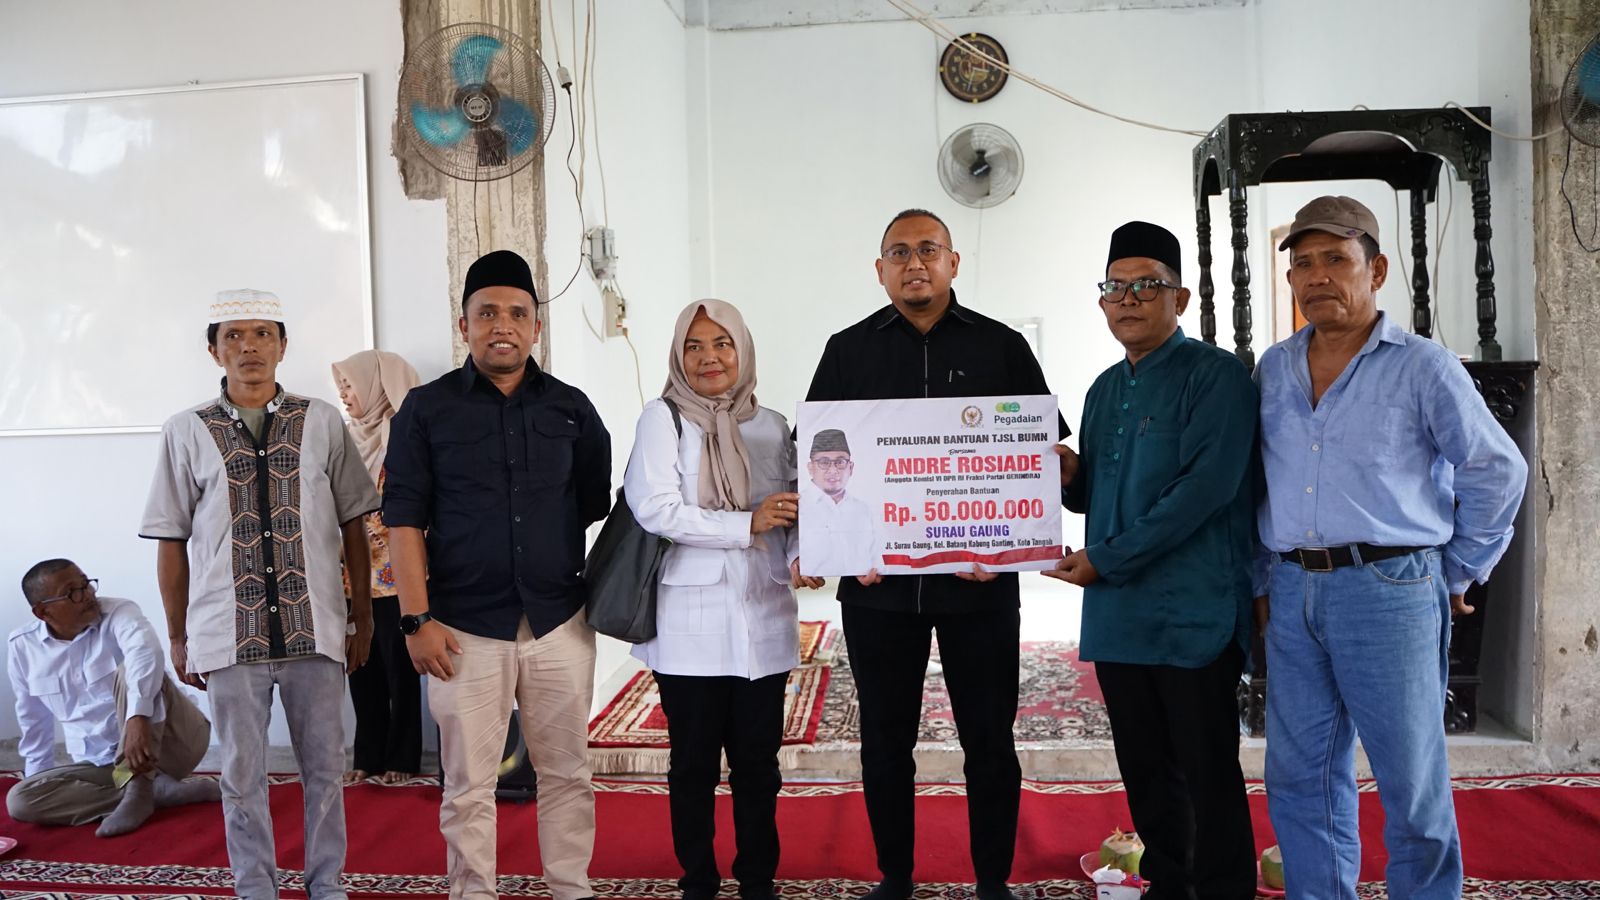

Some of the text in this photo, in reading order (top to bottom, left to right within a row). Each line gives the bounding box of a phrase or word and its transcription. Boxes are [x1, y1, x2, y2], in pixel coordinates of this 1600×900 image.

[994, 414, 1042, 425] Pegadaian
[877, 432, 1048, 446] PENYALURAN BANTUAN TJSL BUMN
[885, 454, 1042, 475] ANDRE ROSIADE
[926, 487, 1000, 497] Penyerahan Bantuan
[884, 498, 1044, 527] Rp. 50.000.000
[926, 525, 1010, 538] SURAU GAUNG
[894, 542, 911, 550] Surau
[946, 540, 967, 549] Batang
[968, 540, 990, 548] Kabung
[1017, 538, 1031, 546] Koto
